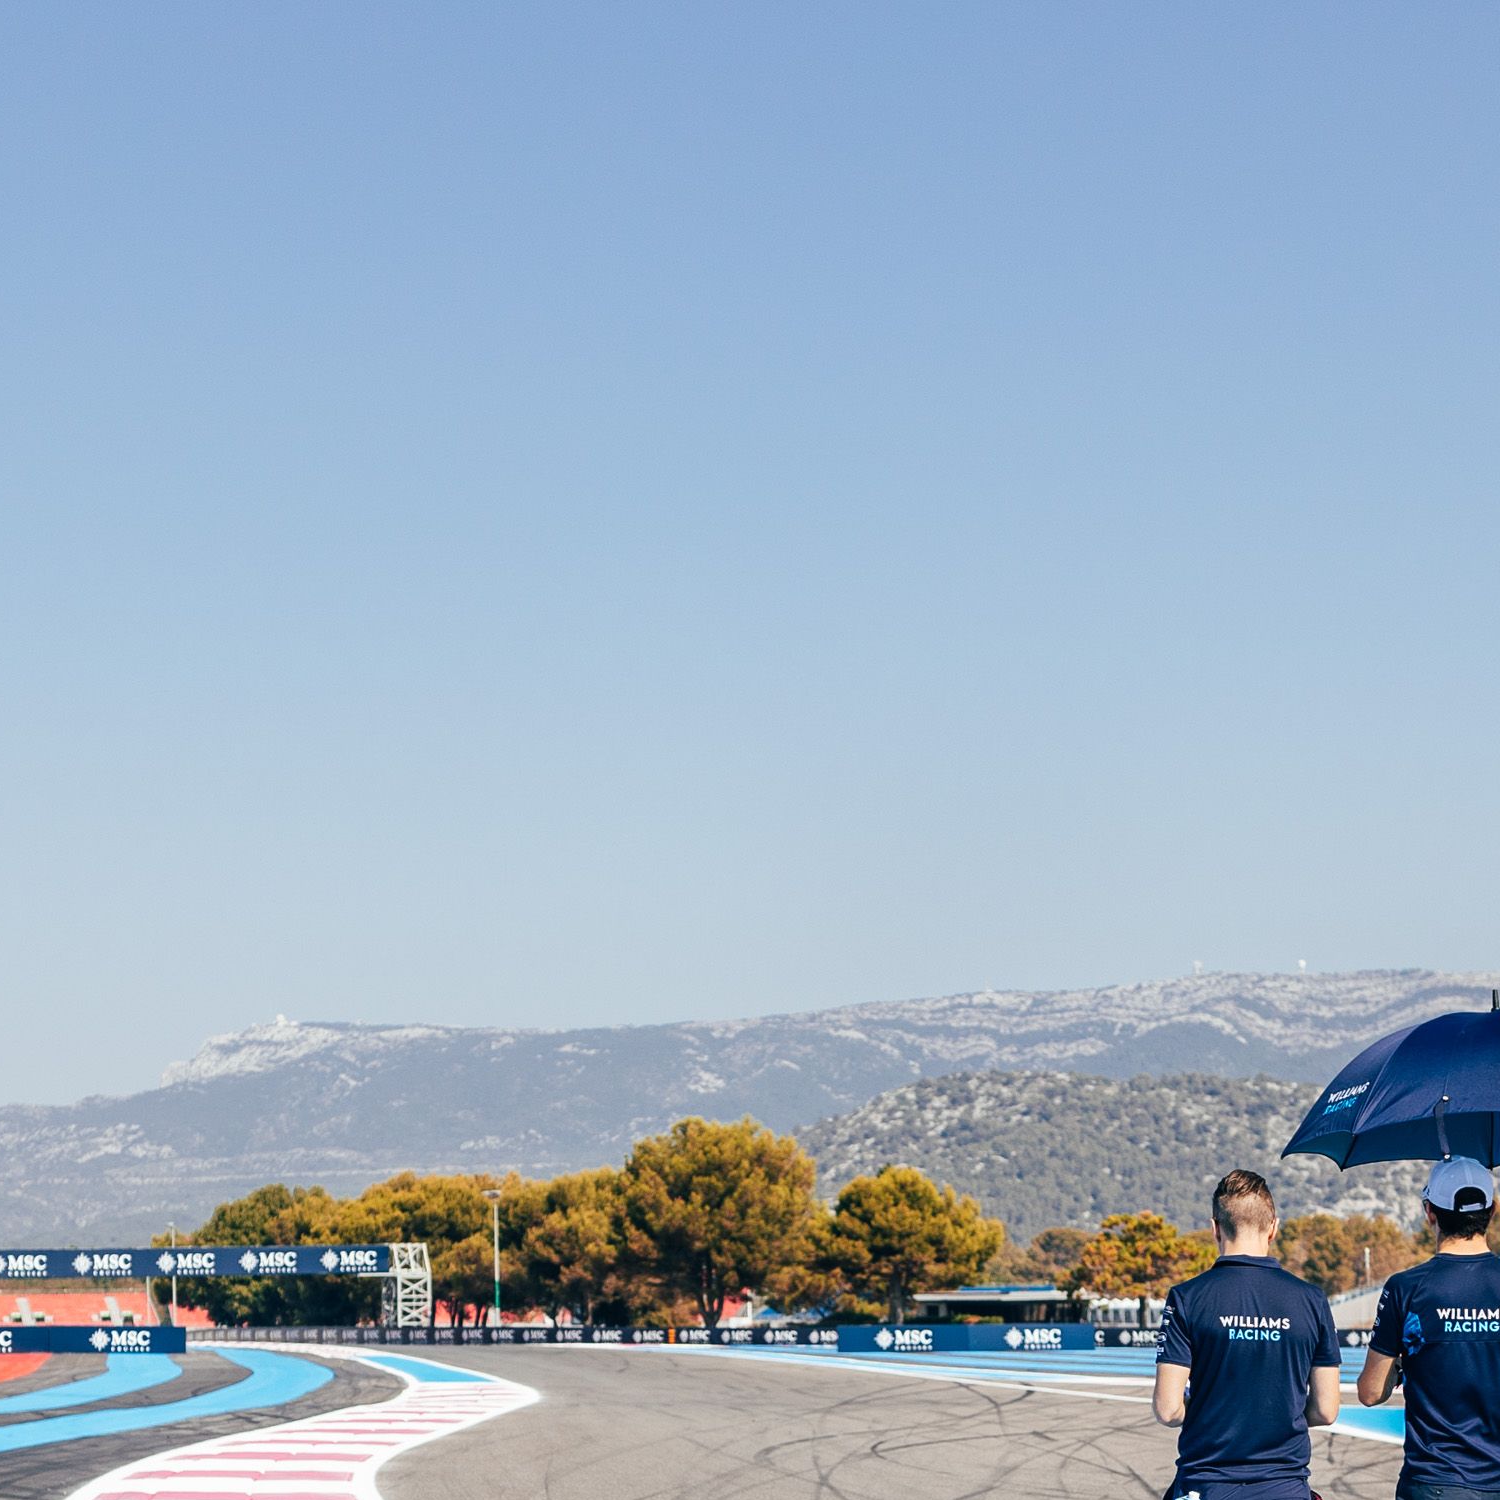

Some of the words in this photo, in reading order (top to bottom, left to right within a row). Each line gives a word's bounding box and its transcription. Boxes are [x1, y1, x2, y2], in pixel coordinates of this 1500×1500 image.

[7, 1254, 47, 1271] MSC
[93, 1253, 132, 1270] MSC
[176, 1252, 216, 1270] MSC
[258, 1251, 298, 1268] MSC
[339, 1250, 378, 1267] MSC
[1219, 1315, 1291, 1330] WILLIAMS
[1444, 1320, 1500, 1333] RACING
[110, 1330, 151, 1347] MSC
[819, 1330, 839, 1343] MS
[893, 1329, 933, 1345] MSC
[1023, 1328, 1062, 1344] MSC
[1228, 1328, 1282, 1341] RACING
